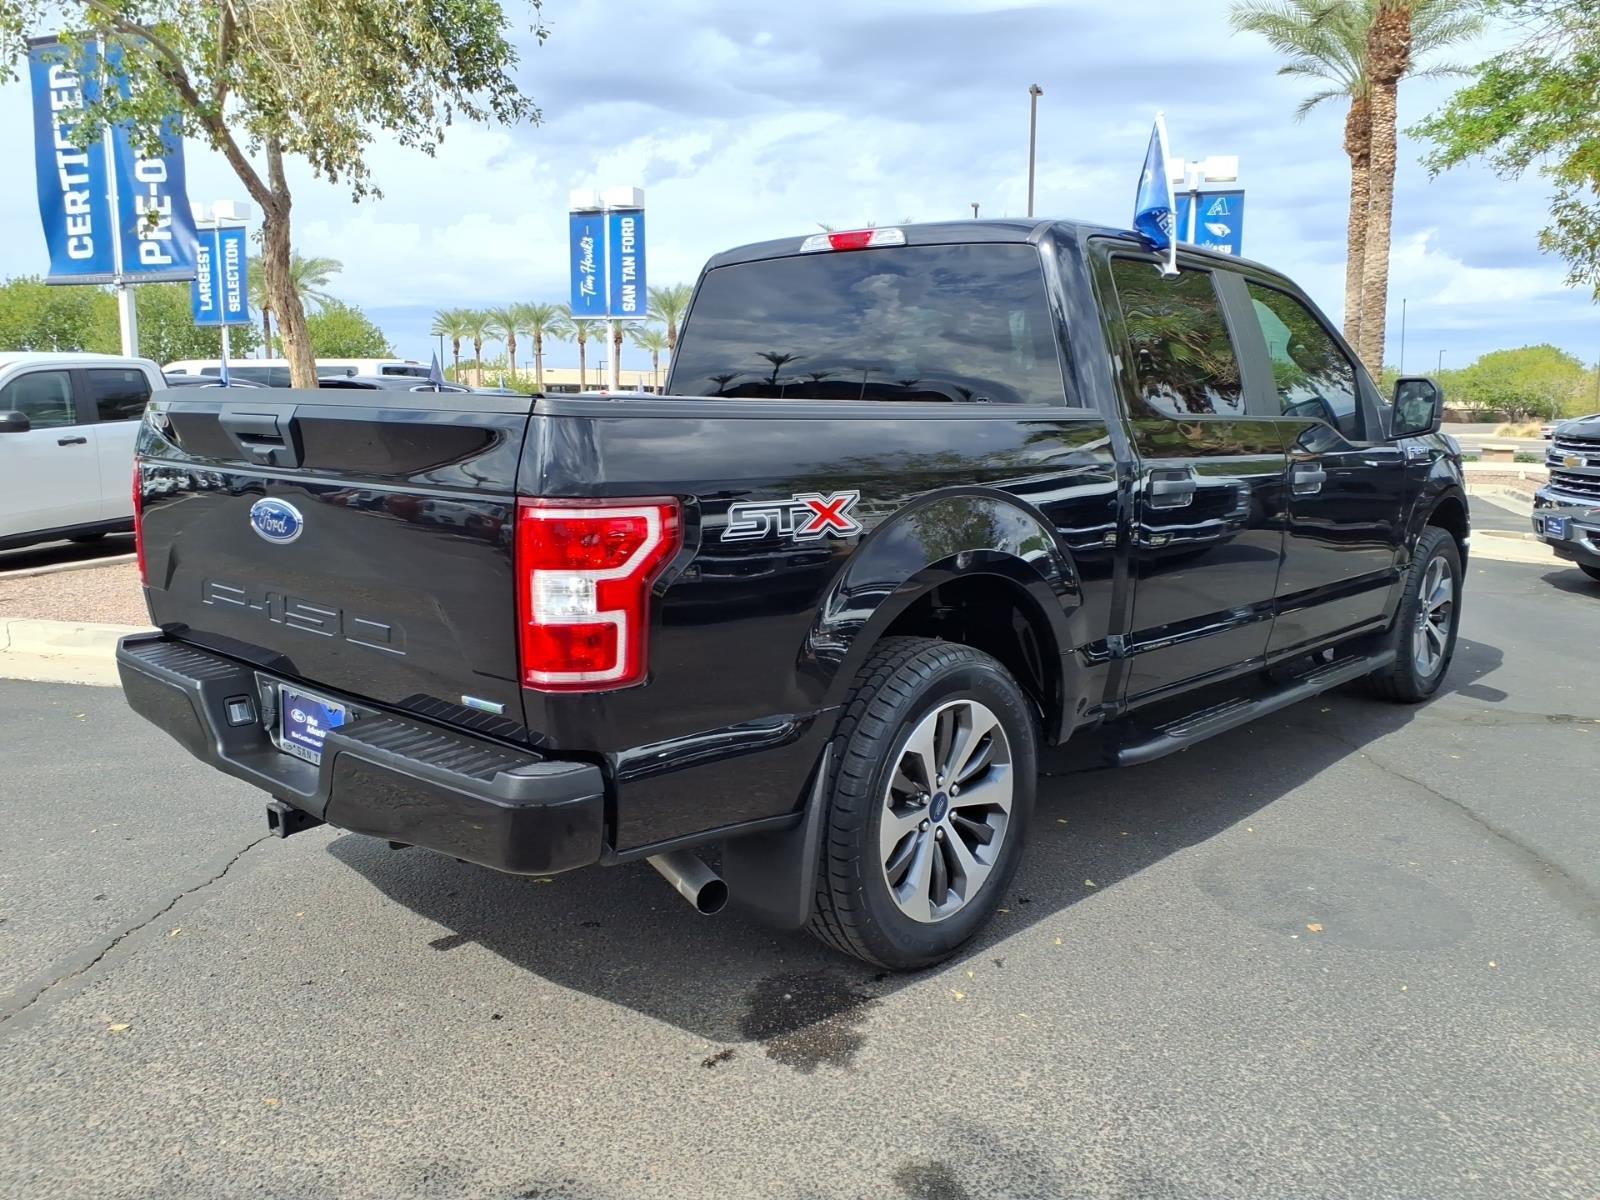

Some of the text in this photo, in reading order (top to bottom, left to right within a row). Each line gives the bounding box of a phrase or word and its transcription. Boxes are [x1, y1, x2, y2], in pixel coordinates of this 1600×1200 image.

[197, 246, 213, 311] LARGEST
[225, 238, 241, 312] SELECTION
[580, 274, 597, 297] Tim
[621, 217, 636, 312] SAN TAN FORD
[258, 506, 287, 533] Ford
[720, 490, 864, 542] STX
[202, 577, 407, 655] F-150
